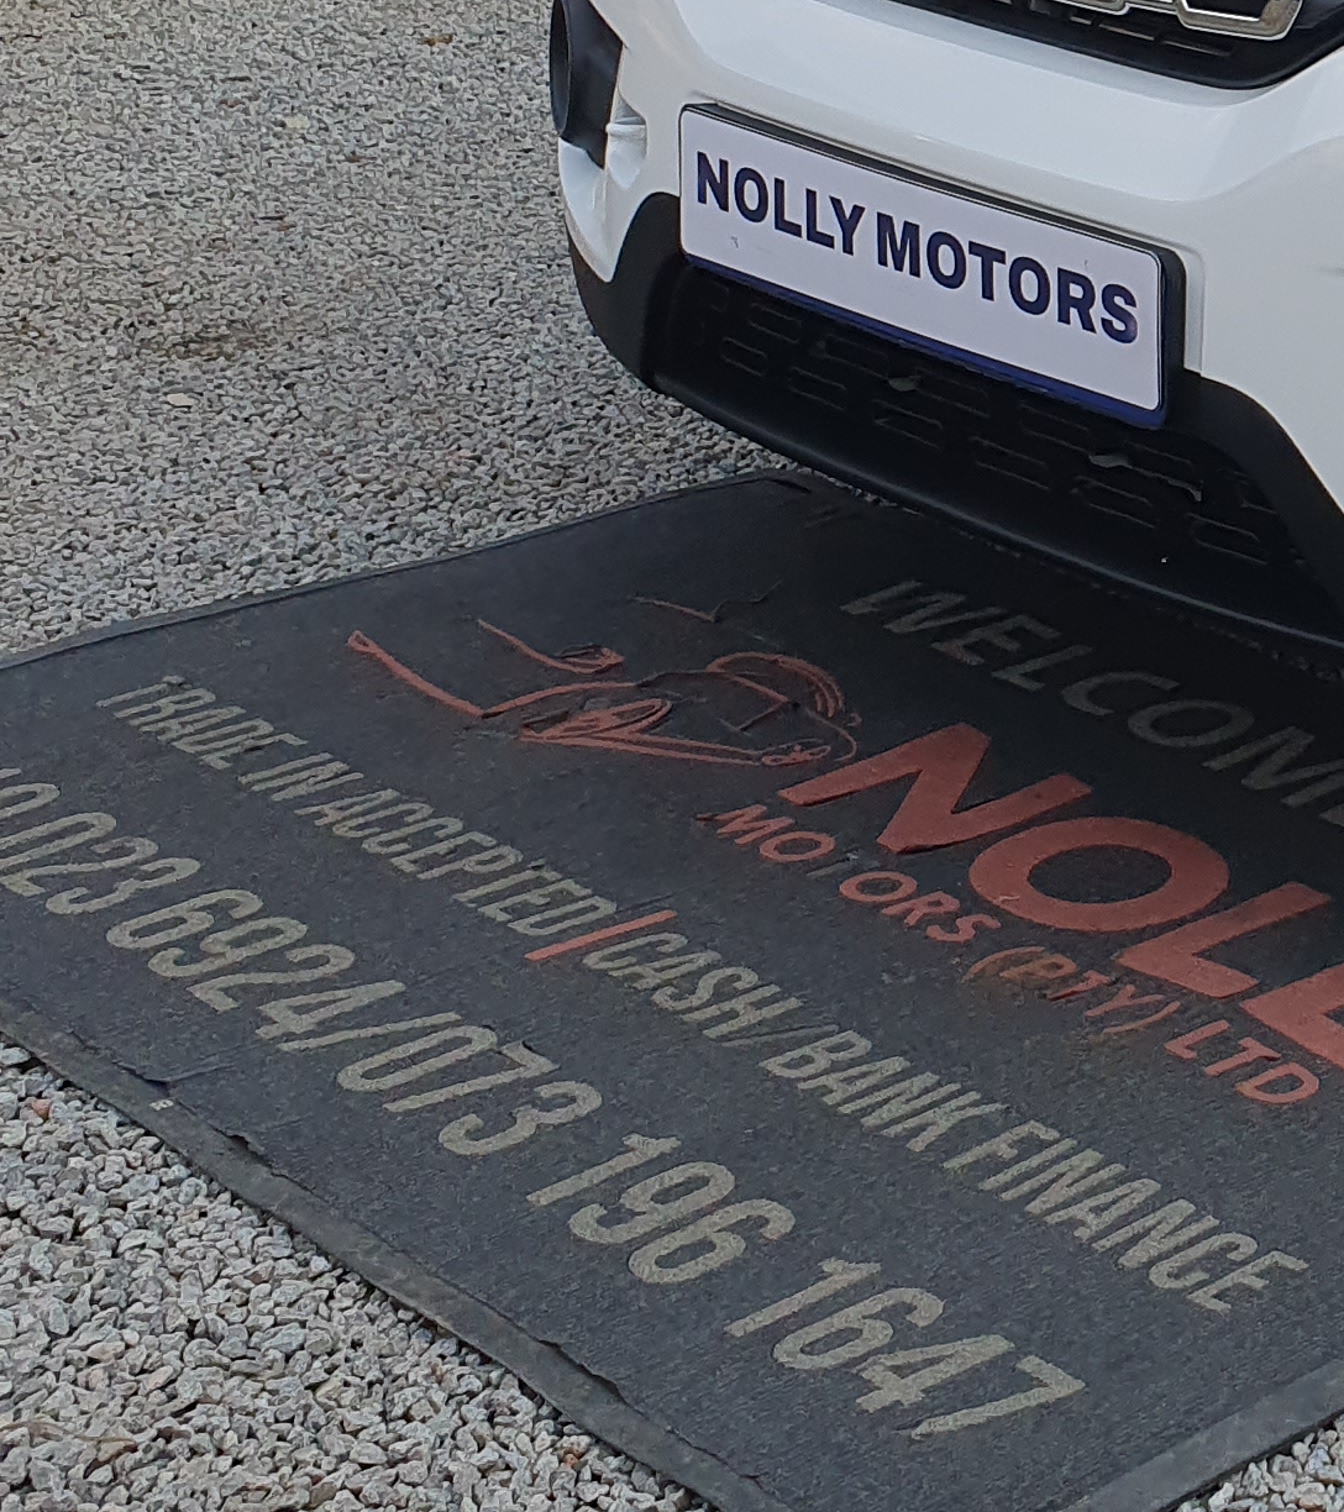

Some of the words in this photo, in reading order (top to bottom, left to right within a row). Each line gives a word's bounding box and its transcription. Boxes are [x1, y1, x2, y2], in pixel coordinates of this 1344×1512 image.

[696, 150, 866, 257] NOLLY
[876, 211, 1140, 345] MOTORS
[95, 675, 308, 771] TRADE
[237, 751, 365, 802] IN
[293, 787, 618, 937] ACCEPTED
[960, 945, 1182, 1036] (PTY)
[1163, 1019, 1321, 1104] LTD
[525, 1132, 797, 1284] 196
[723, 1257, 1088, 1441] 1647
[941, 1120, 1311, 1315] FINANCE
